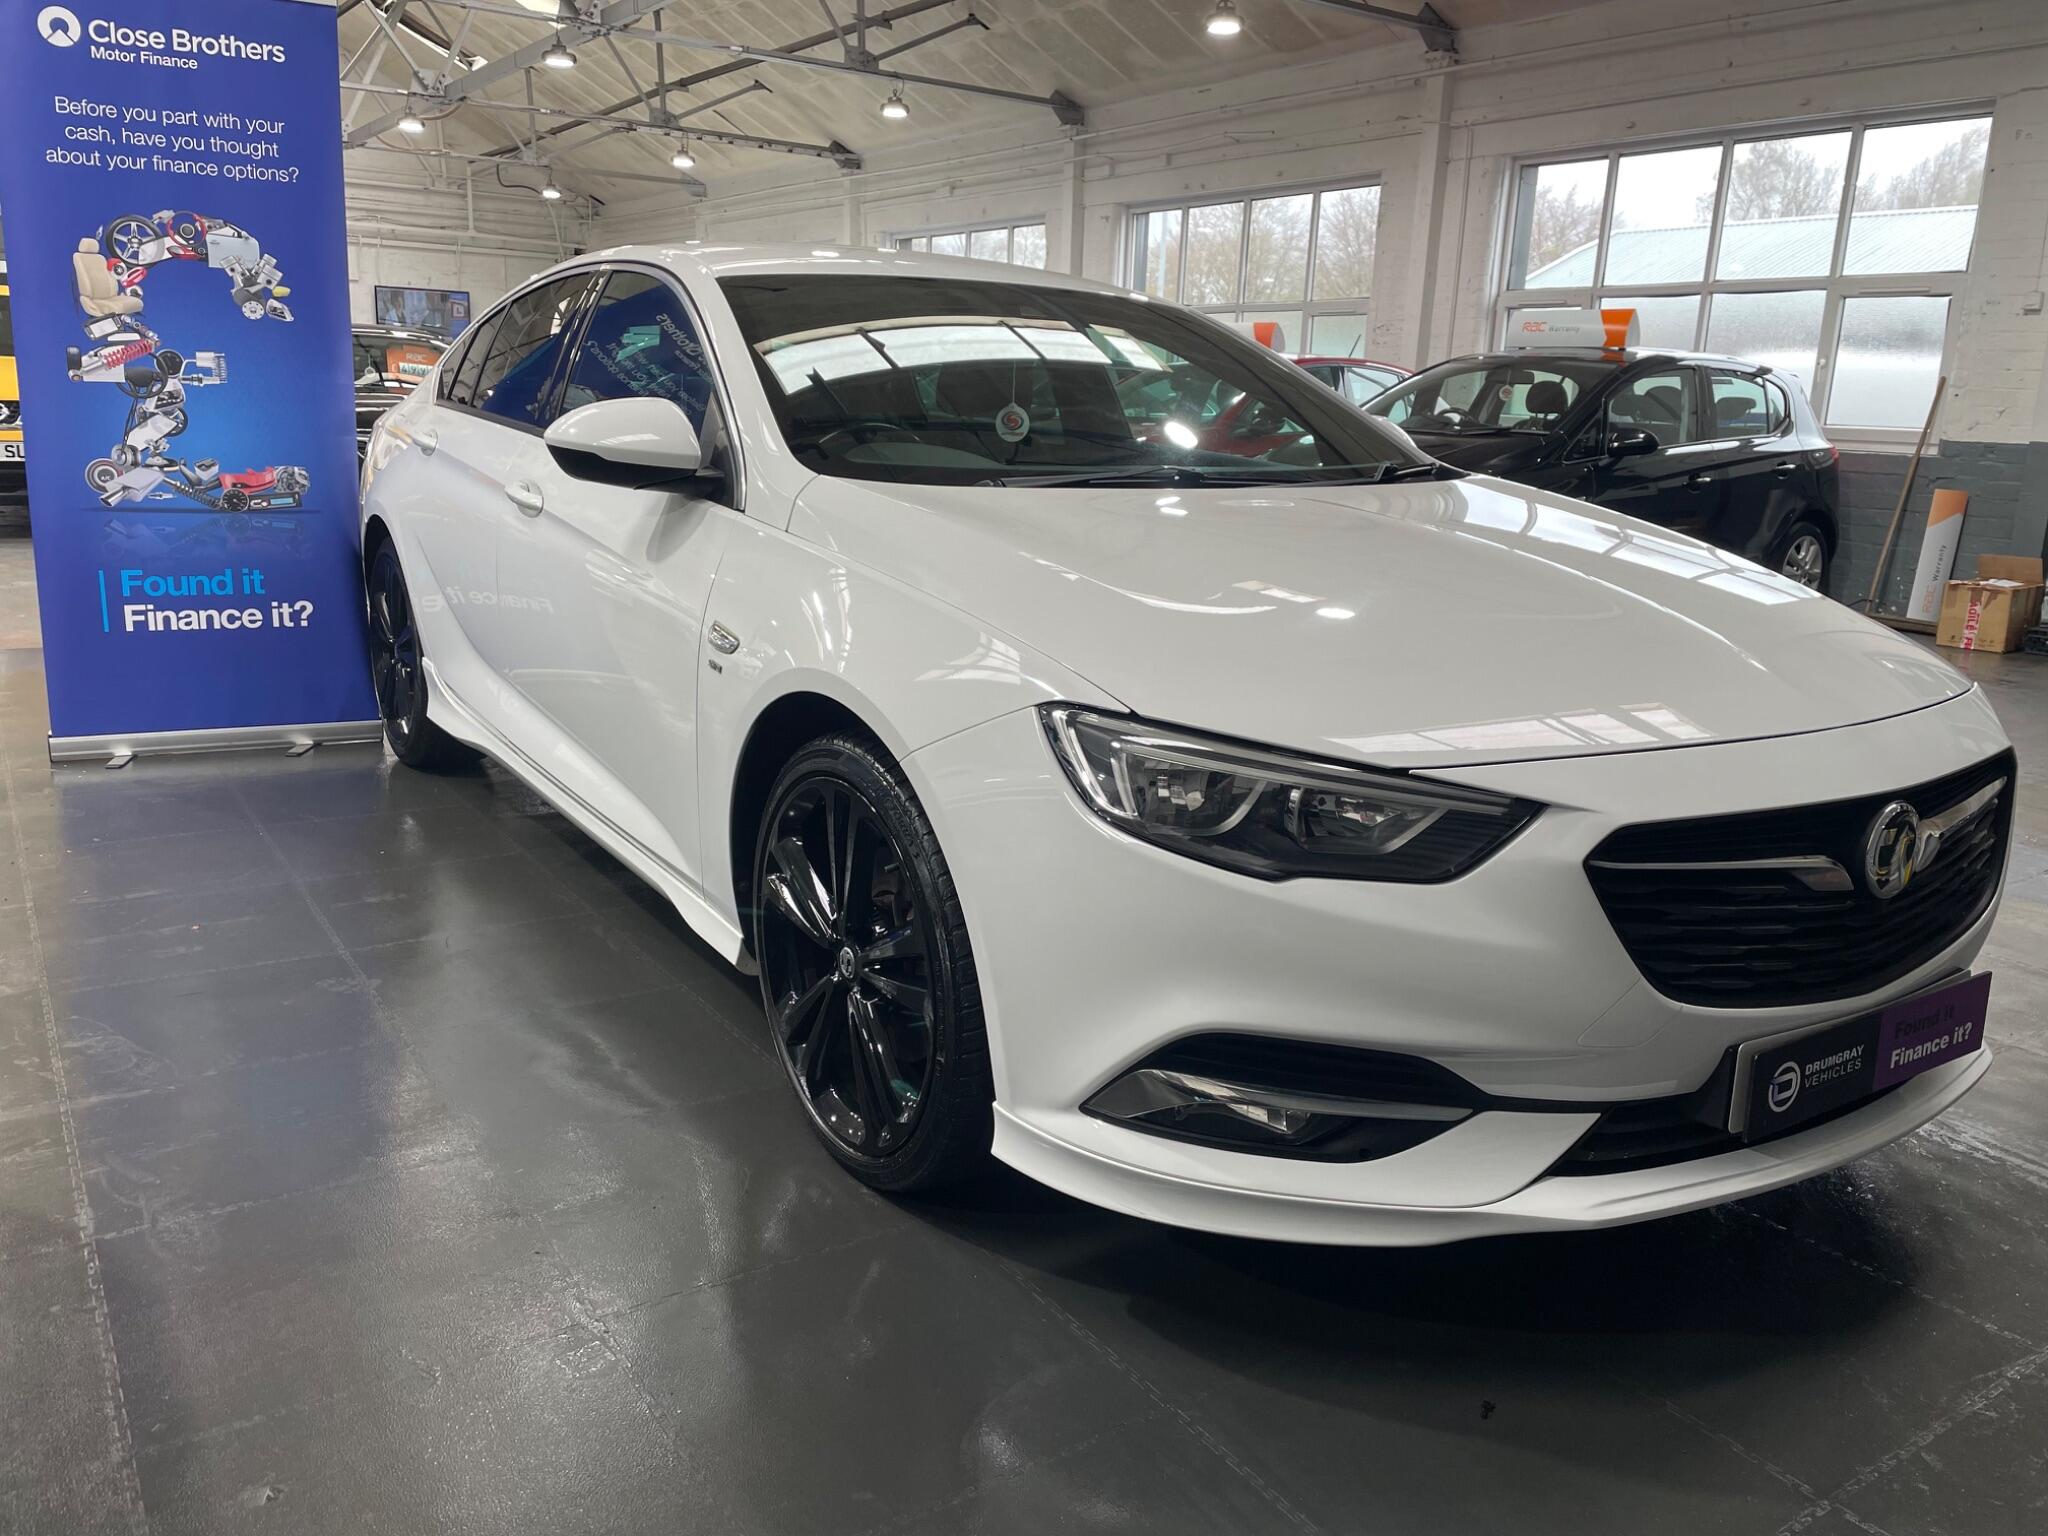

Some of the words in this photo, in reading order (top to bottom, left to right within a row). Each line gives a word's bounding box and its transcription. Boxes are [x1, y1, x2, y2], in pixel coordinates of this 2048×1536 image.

[88, 18, 166, 49] Close
[172, 28, 286, 63] Brothers
[90, 45, 137, 63] Motor
[140, 52, 198, 69] Finance
[54, 95, 117, 118] Before
[122, 107, 156, 123] you
[162, 109, 198, 126] part
[203, 112, 240, 130] with
[245, 118, 285, 134] your
[65, 125, 116, 145] cash,
[122, 128, 166, 147] have
[171, 136, 205, 152] you
[210, 137, 280, 159] thought
[46, 147, 101, 166] about
[106, 154, 147, 171] your
[152, 155, 218, 176] finance
[223, 164, 299, 183] options?
[1932, 544, 1948, 582] Warranty
[120, 568, 234, 597] Found
[241, 568, 265, 595] it
[123, 604, 263, 632] Finance
[271, 600, 314, 628] it?
[1894, 1013, 1942, 1040] Found
[1805, 1044, 1865, 1076] DRUMGRAY
[1889, 1034, 1950, 1069] Finance
[1952, 1022, 1973, 1045] it?
[1804, 1057, 1862, 1088] VEHICLES
